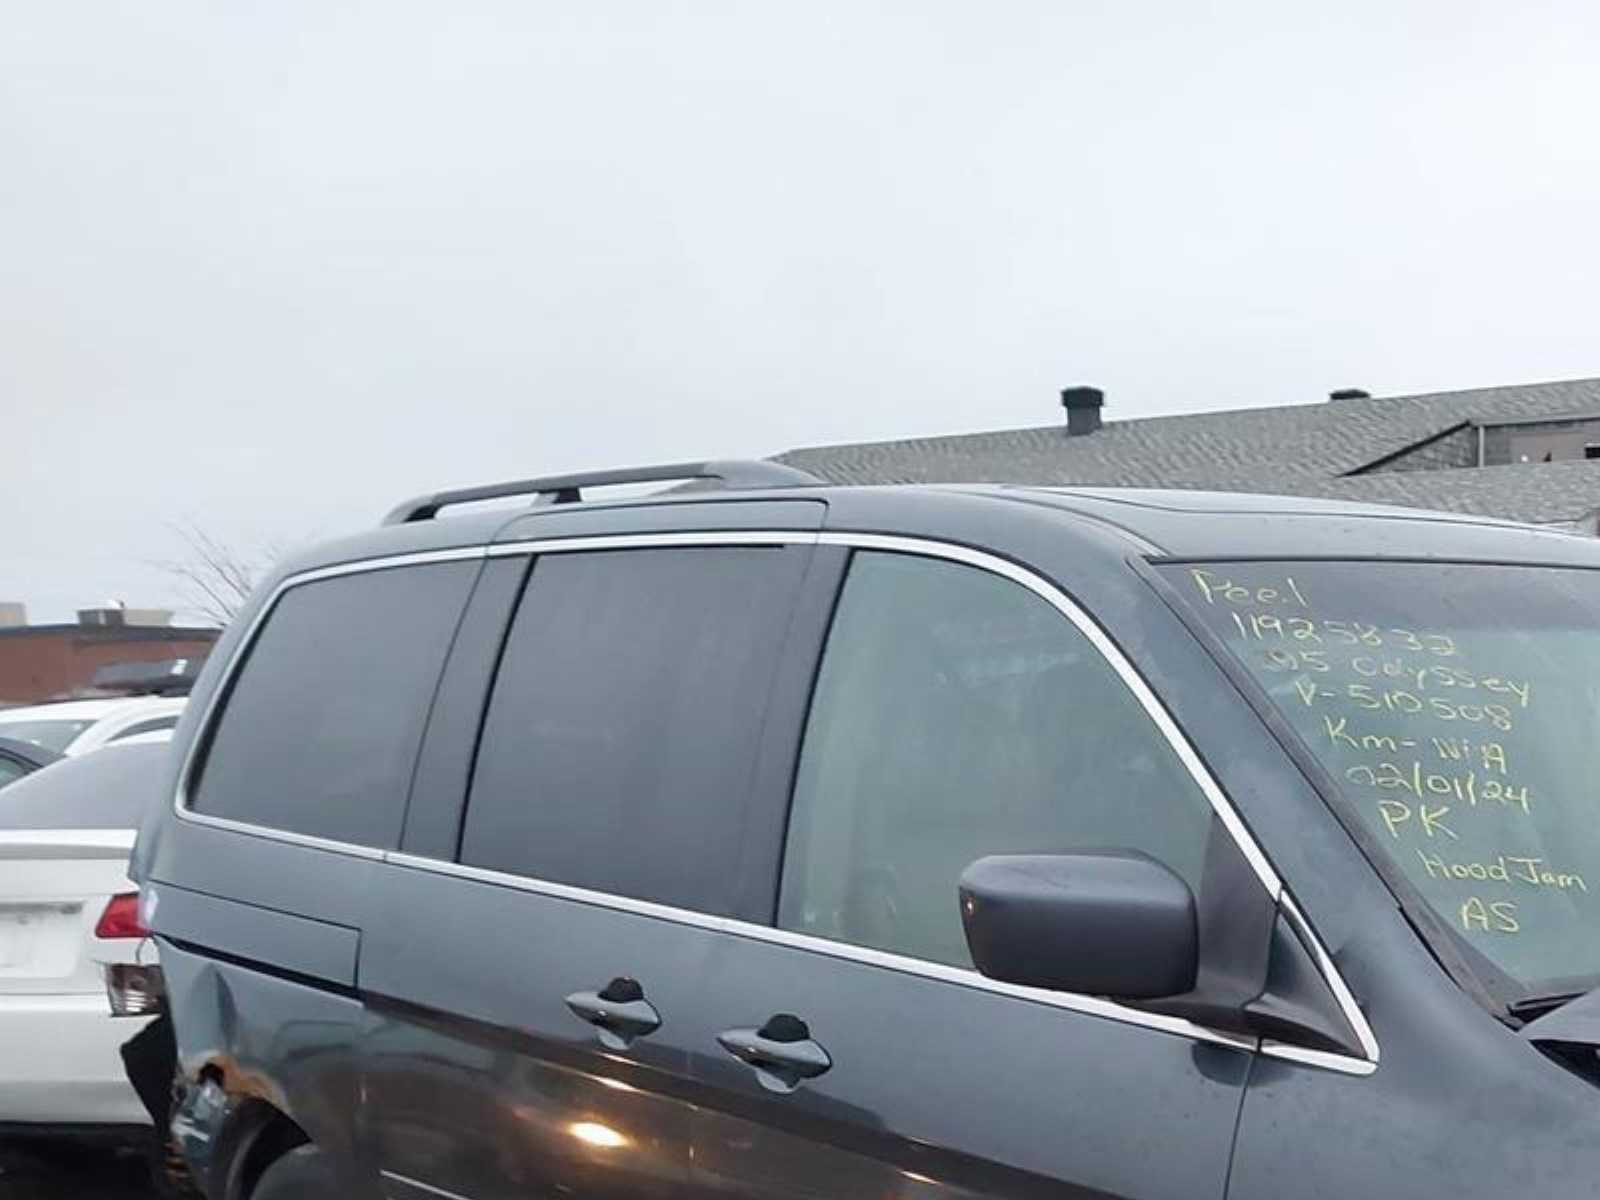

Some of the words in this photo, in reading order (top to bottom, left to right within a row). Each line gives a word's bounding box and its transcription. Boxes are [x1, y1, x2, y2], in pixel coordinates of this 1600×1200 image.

[1231, 610, 1457, 657] 11925832
[1507, 856, 1588, 893] Jam
[1460, 896, 1520, 933] AS
